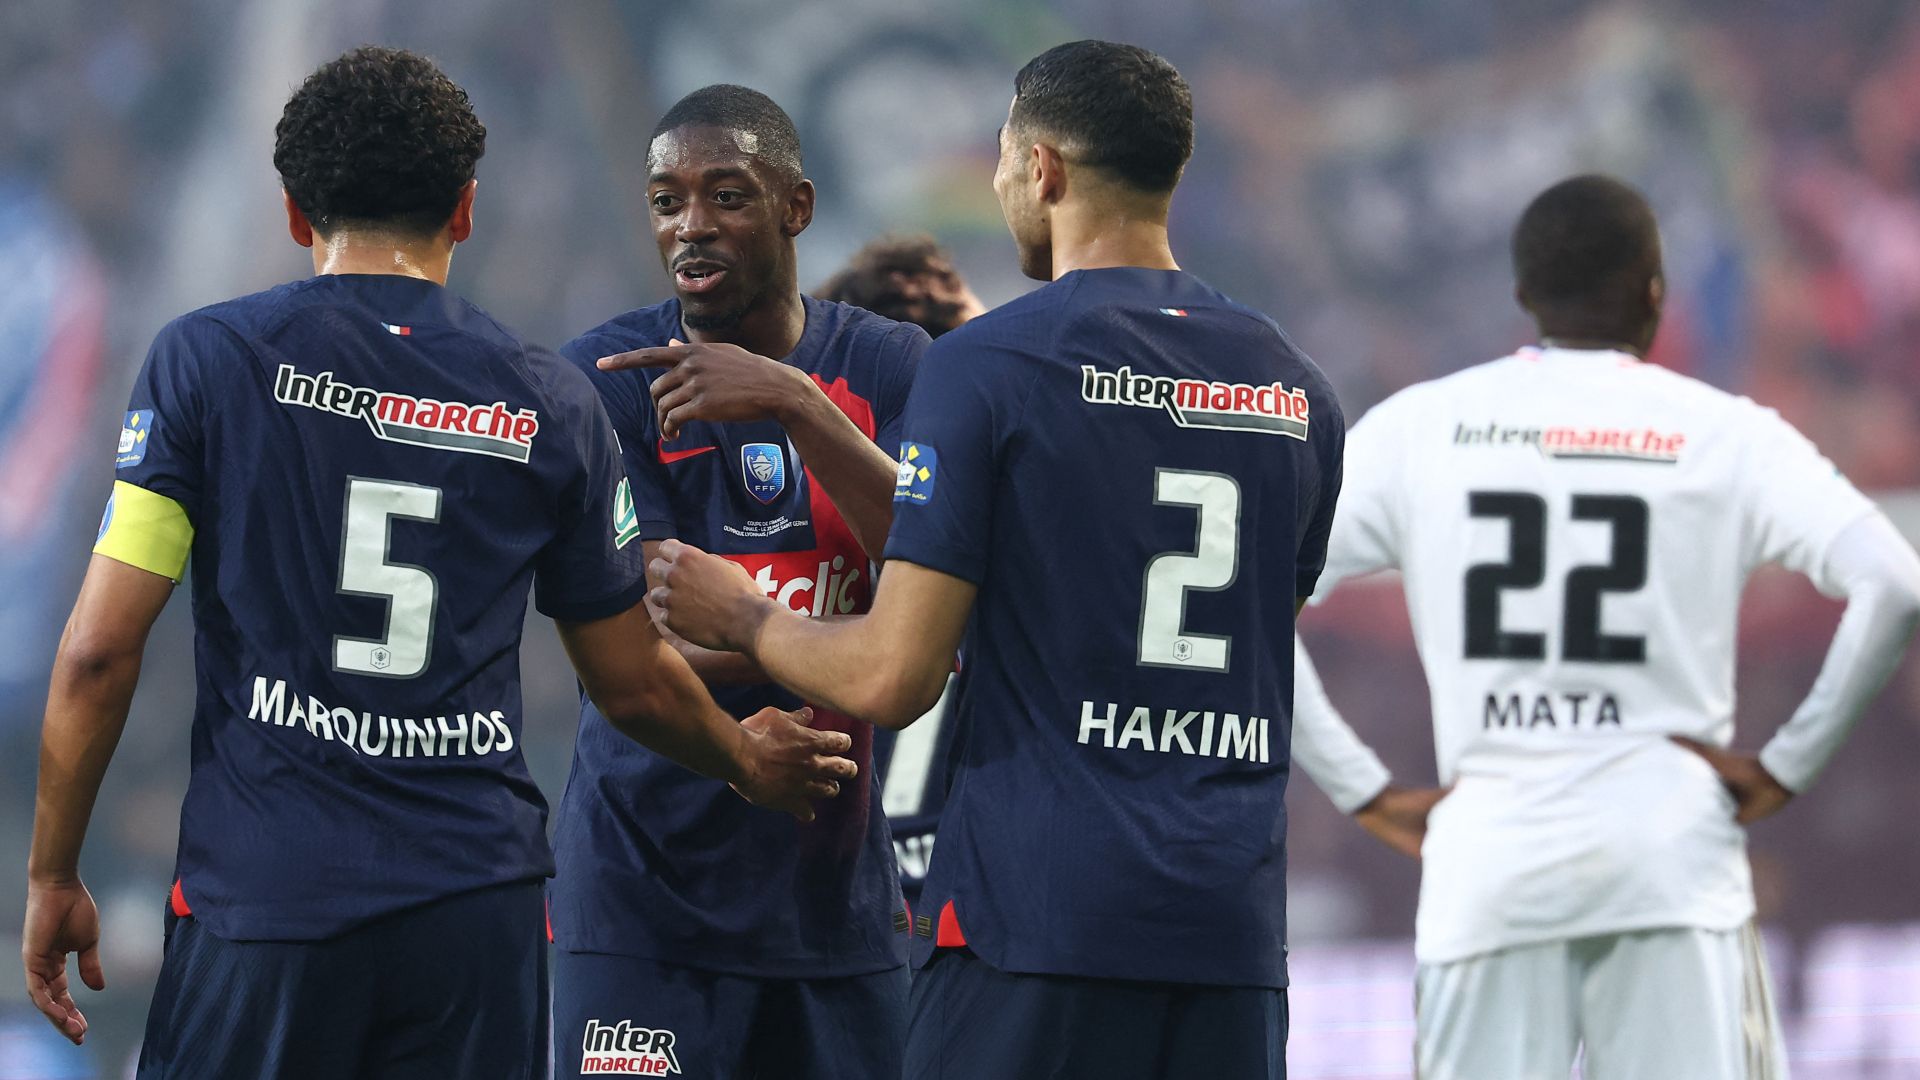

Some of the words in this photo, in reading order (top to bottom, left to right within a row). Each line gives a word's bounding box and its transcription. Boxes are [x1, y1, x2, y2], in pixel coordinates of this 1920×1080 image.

[332, 475, 442, 679] 5
[1136, 466, 1242, 673] 2
[1462, 490, 1649, 665] 22
[248, 676, 514, 757] MARQUINHOS
[1077, 700, 1269, 763] HAKIMI
[1483, 693, 1621, 729] MATA
